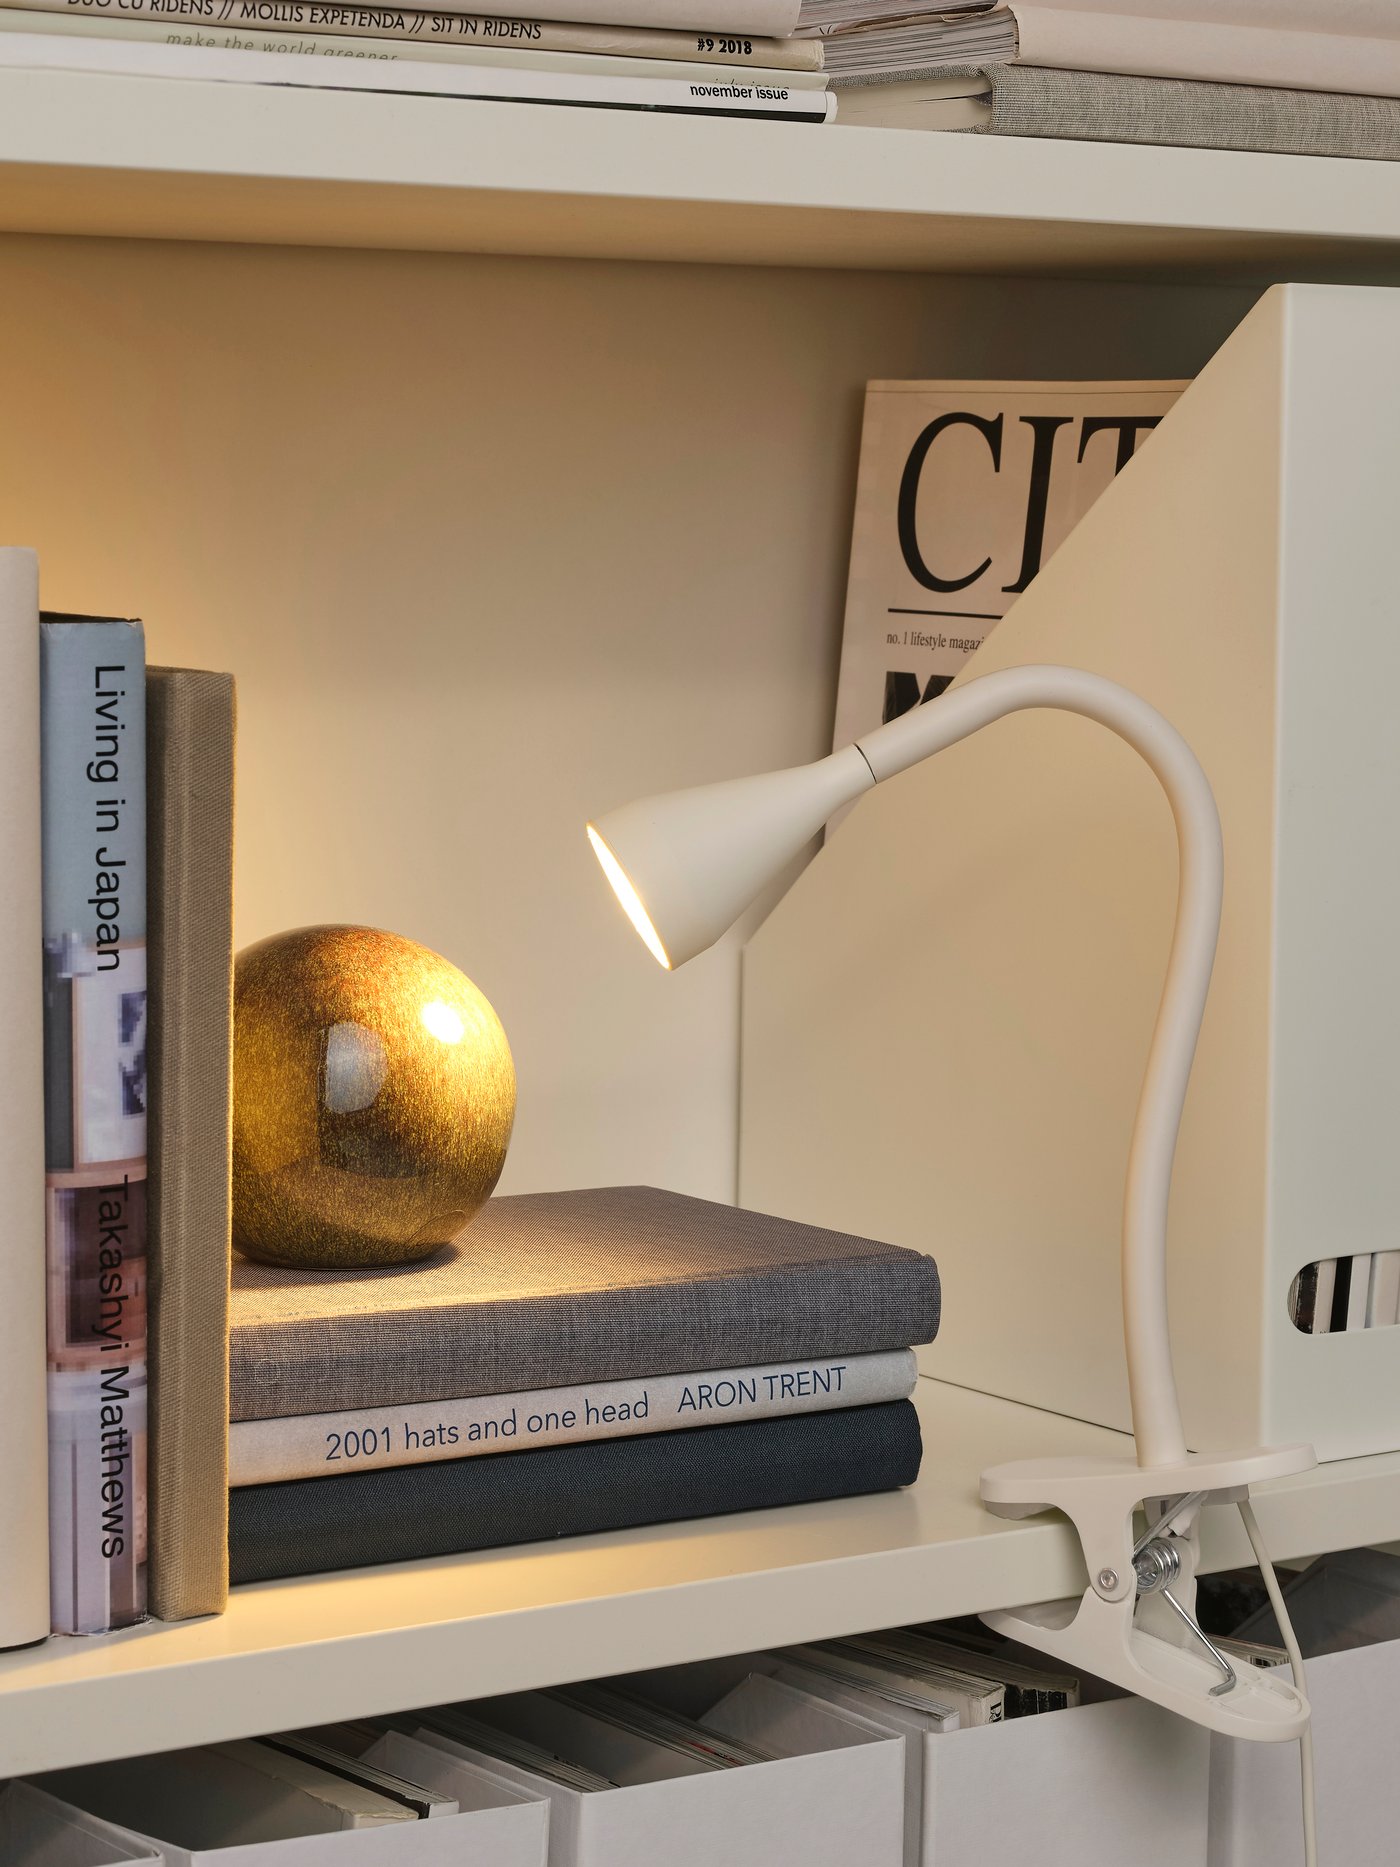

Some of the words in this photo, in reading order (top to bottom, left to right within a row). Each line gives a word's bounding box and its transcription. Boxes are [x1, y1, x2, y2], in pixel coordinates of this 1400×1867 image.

[150, 0, 214, 16] RIDENS
[240, 2, 304, 23] MOLLIS
[309, 7, 406, 30] EXPETENDA
[431, 17, 455, 33] SIT
[459, 19, 478, 35] IN
[483, 20, 542, 40] RIDENS
[166, 32, 216, 48] make
[224, 35, 254, 51] the
[263, 41, 317, 55] world
[697, 38, 715, 52] #9
[719, 39, 753, 55] 2018
[690, 85, 753, 99] november
[755, 86, 789, 100] issue
[886, 633, 901, 645] no.
[910, 631, 948, 651] lifestyle
[86, 665, 126, 783] Living
[96, 799, 126, 833] in
[87, 847, 127, 972] Japan
[91, 1174, 130, 1352] Takashyi
[325, 1426, 391, 1461] 2001
[404, 1422, 460, 1450] hats
[467, 1408, 517, 1441] and
[527, 1409, 577, 1433] one
[585, 1390, 649, 1426] head
[677, 1377, 757, 1413] ARON
[762, 1366, 847, 1400] TRENT
[100, 1366, 130, 1559] Matthews
